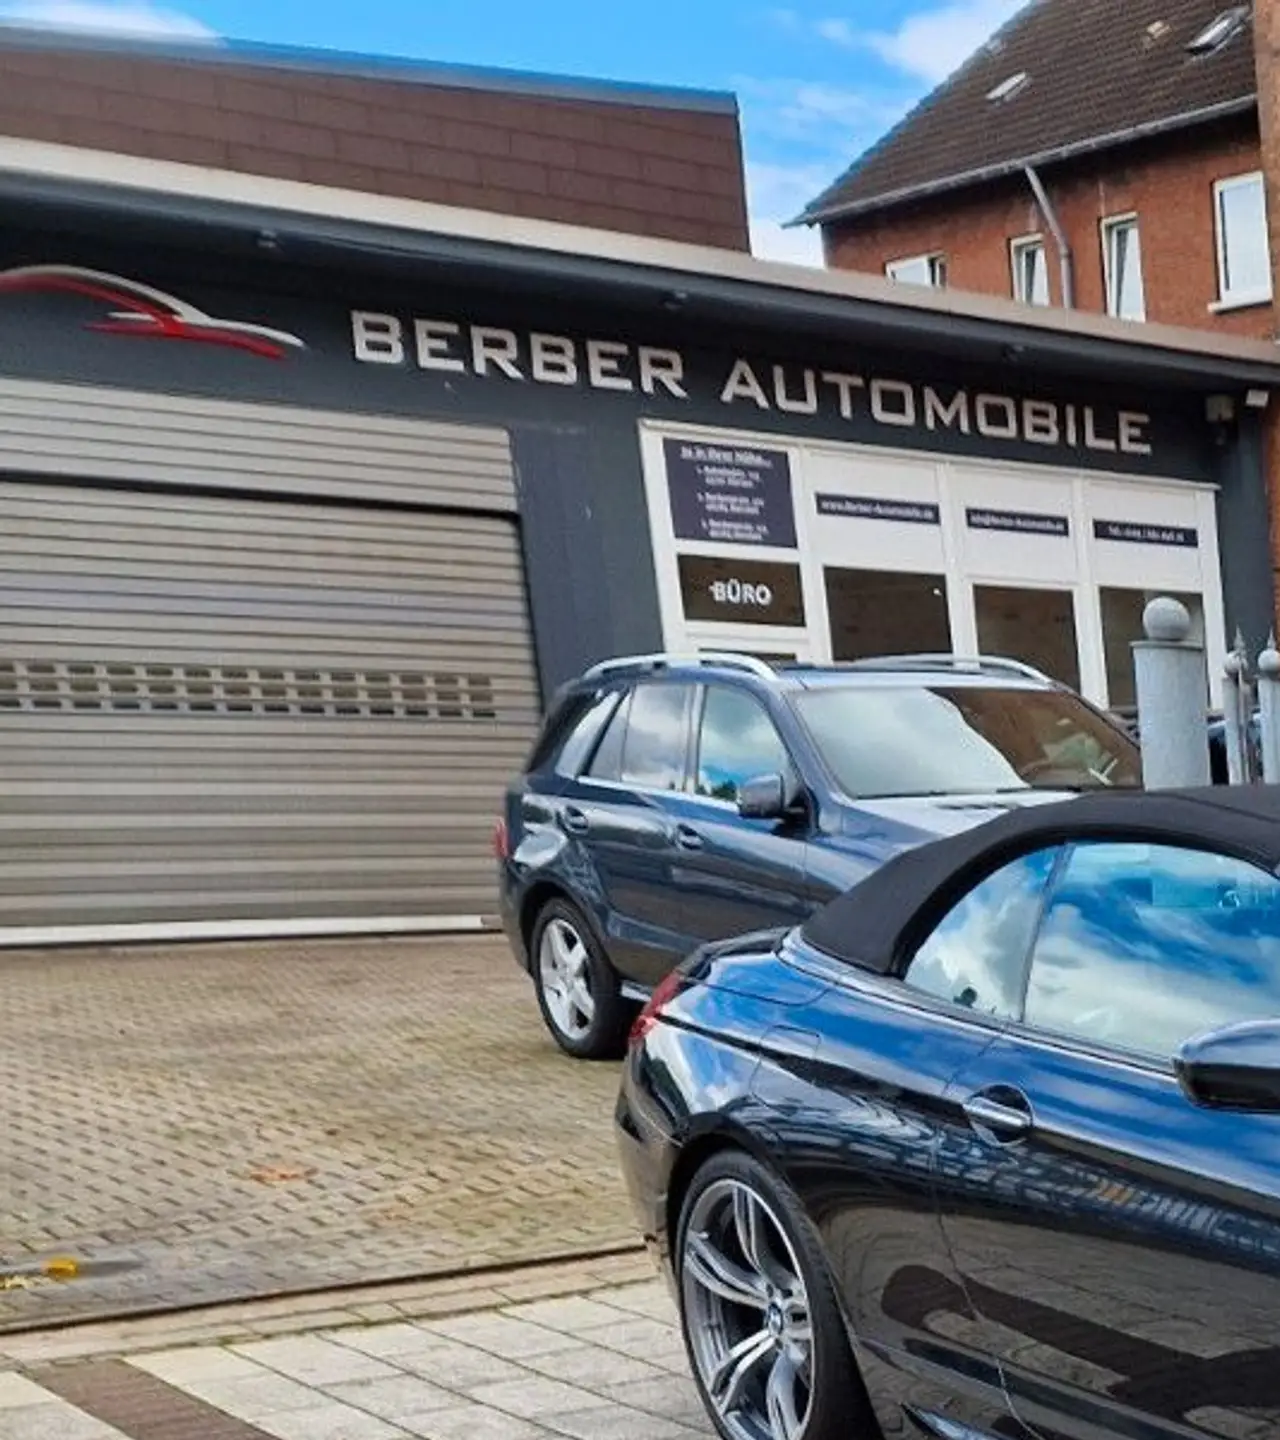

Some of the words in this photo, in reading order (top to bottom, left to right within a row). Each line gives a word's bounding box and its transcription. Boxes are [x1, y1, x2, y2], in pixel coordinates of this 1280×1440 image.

[350, 309, 689, 399] BERBER
[720, 360, 1152, 455] AUTOMOBILE
[711, 578, 772, 606] BÜRO
